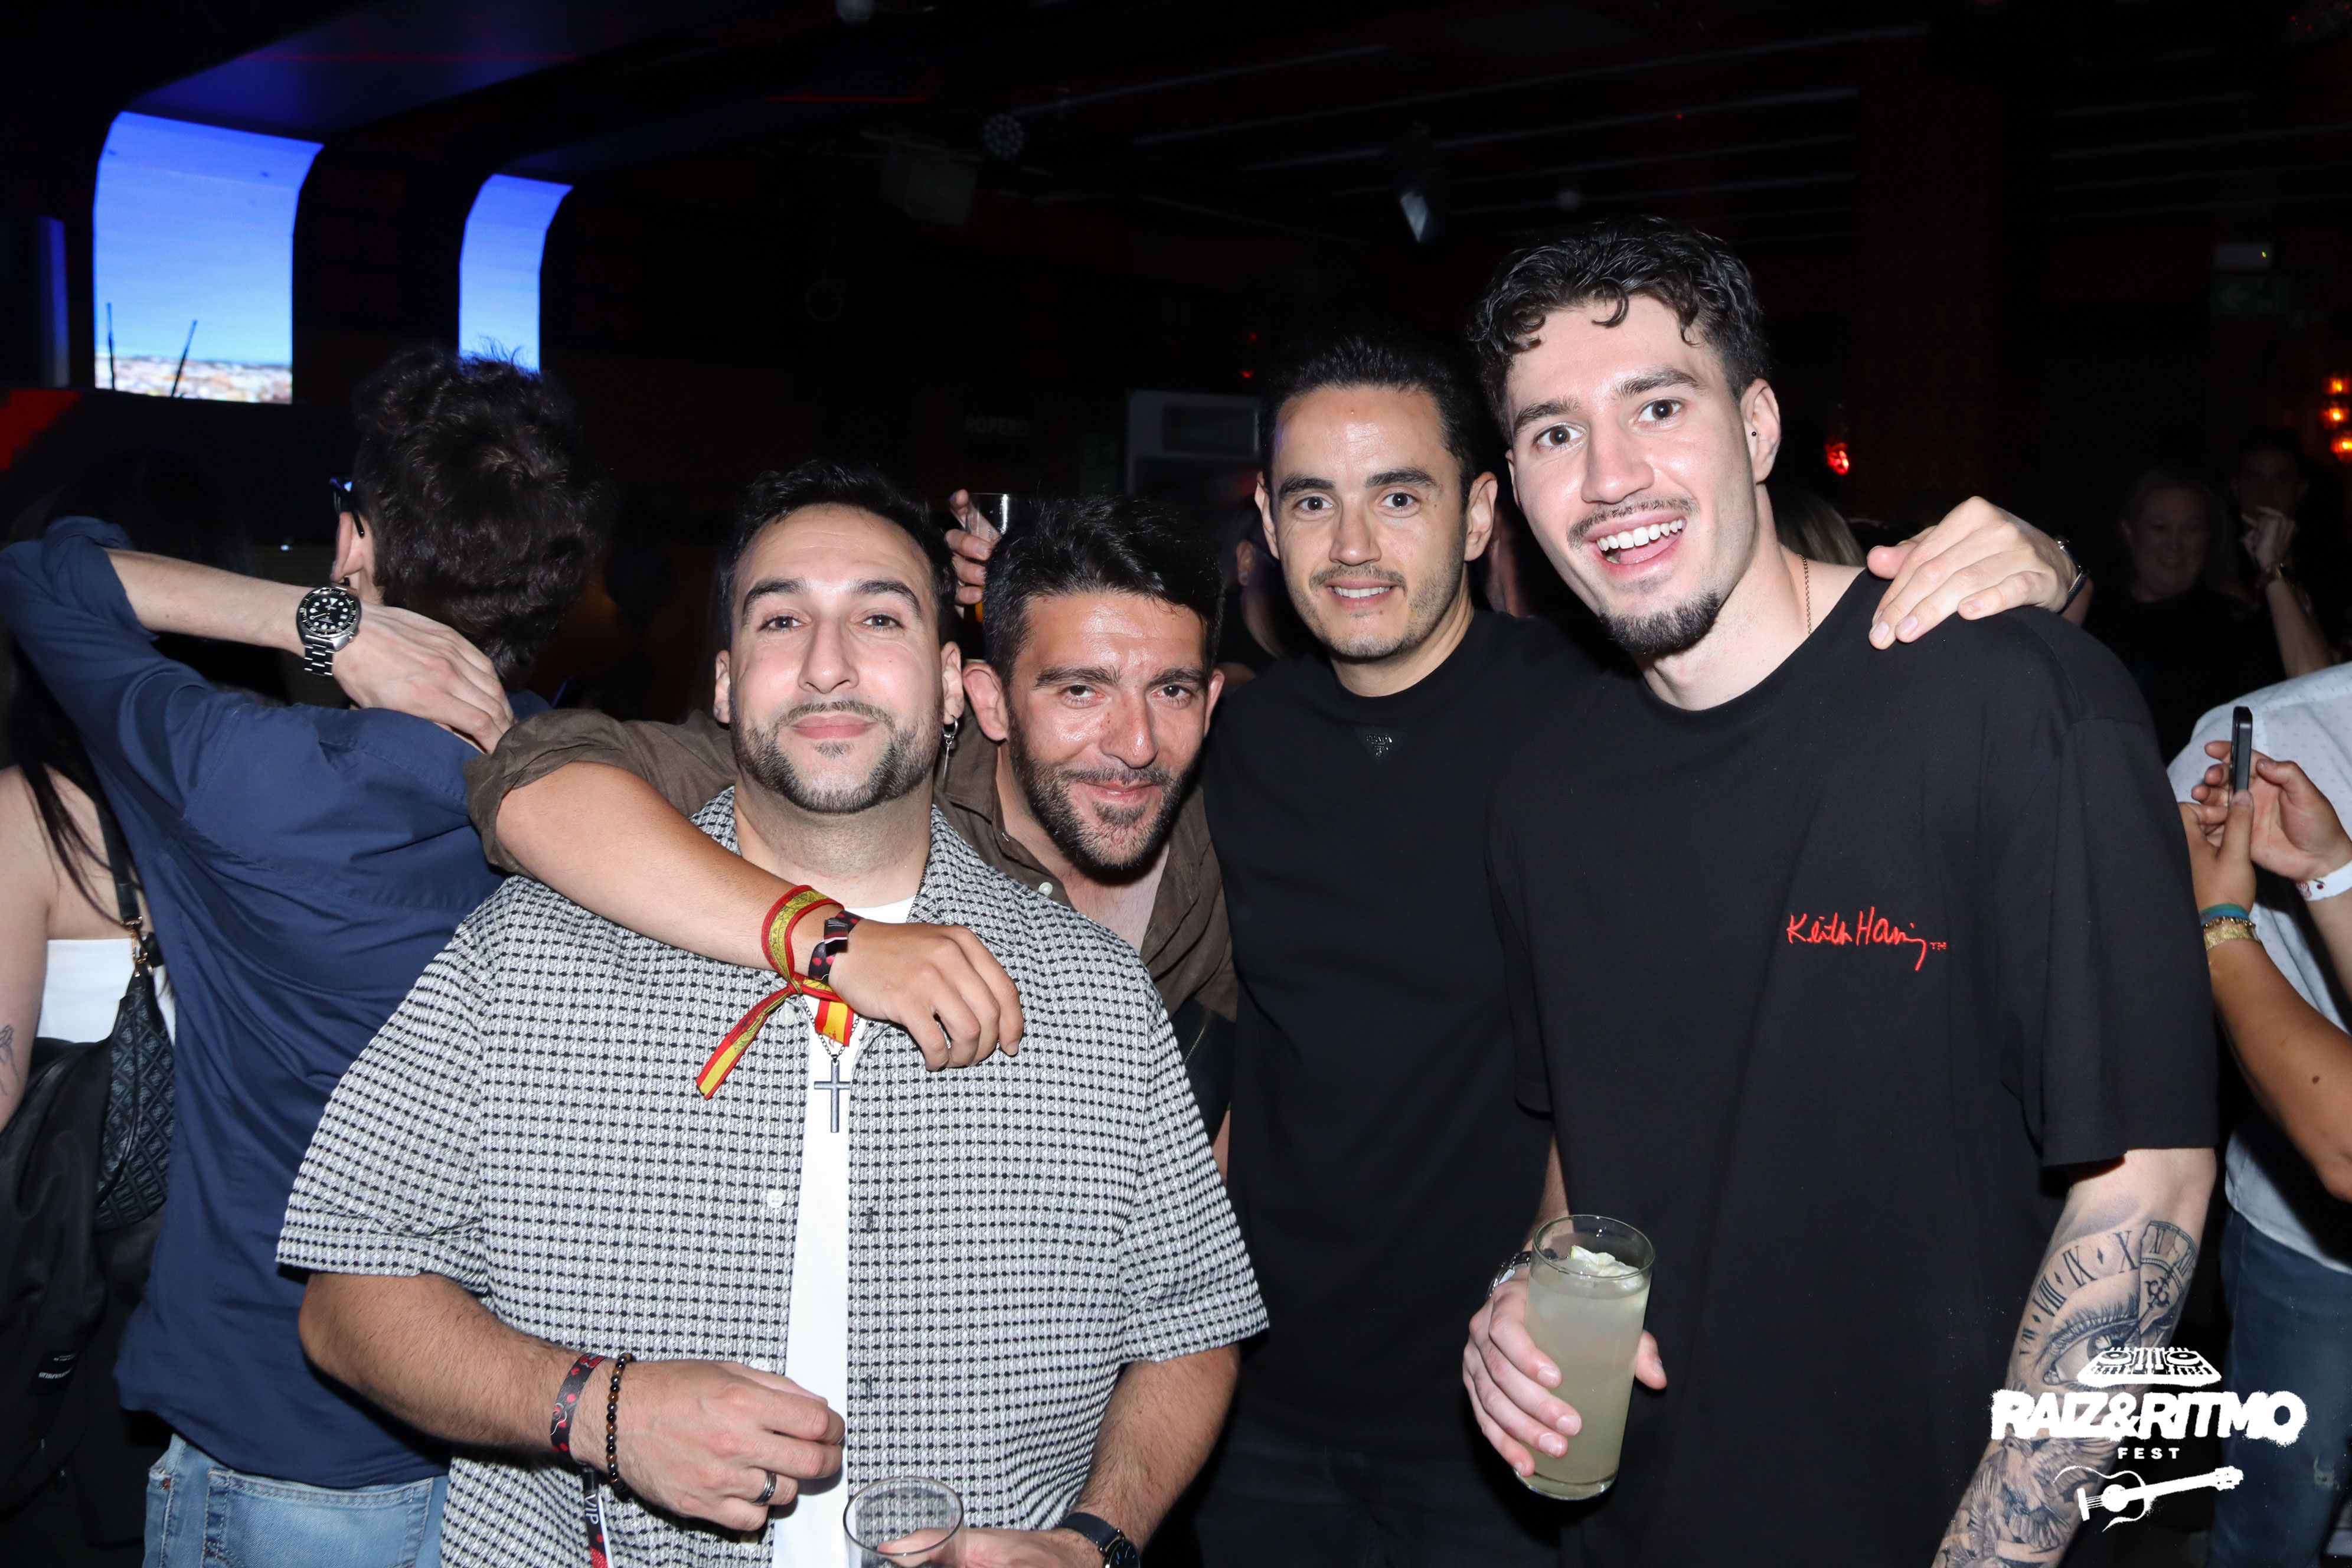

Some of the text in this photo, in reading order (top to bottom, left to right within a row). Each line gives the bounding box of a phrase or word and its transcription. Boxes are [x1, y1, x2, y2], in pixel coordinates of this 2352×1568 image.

[963, 416, 1030, 437] ROPERO
[1786, 912, 1853, 945] Keith
[584, 1494, 599, 1524] VIP
